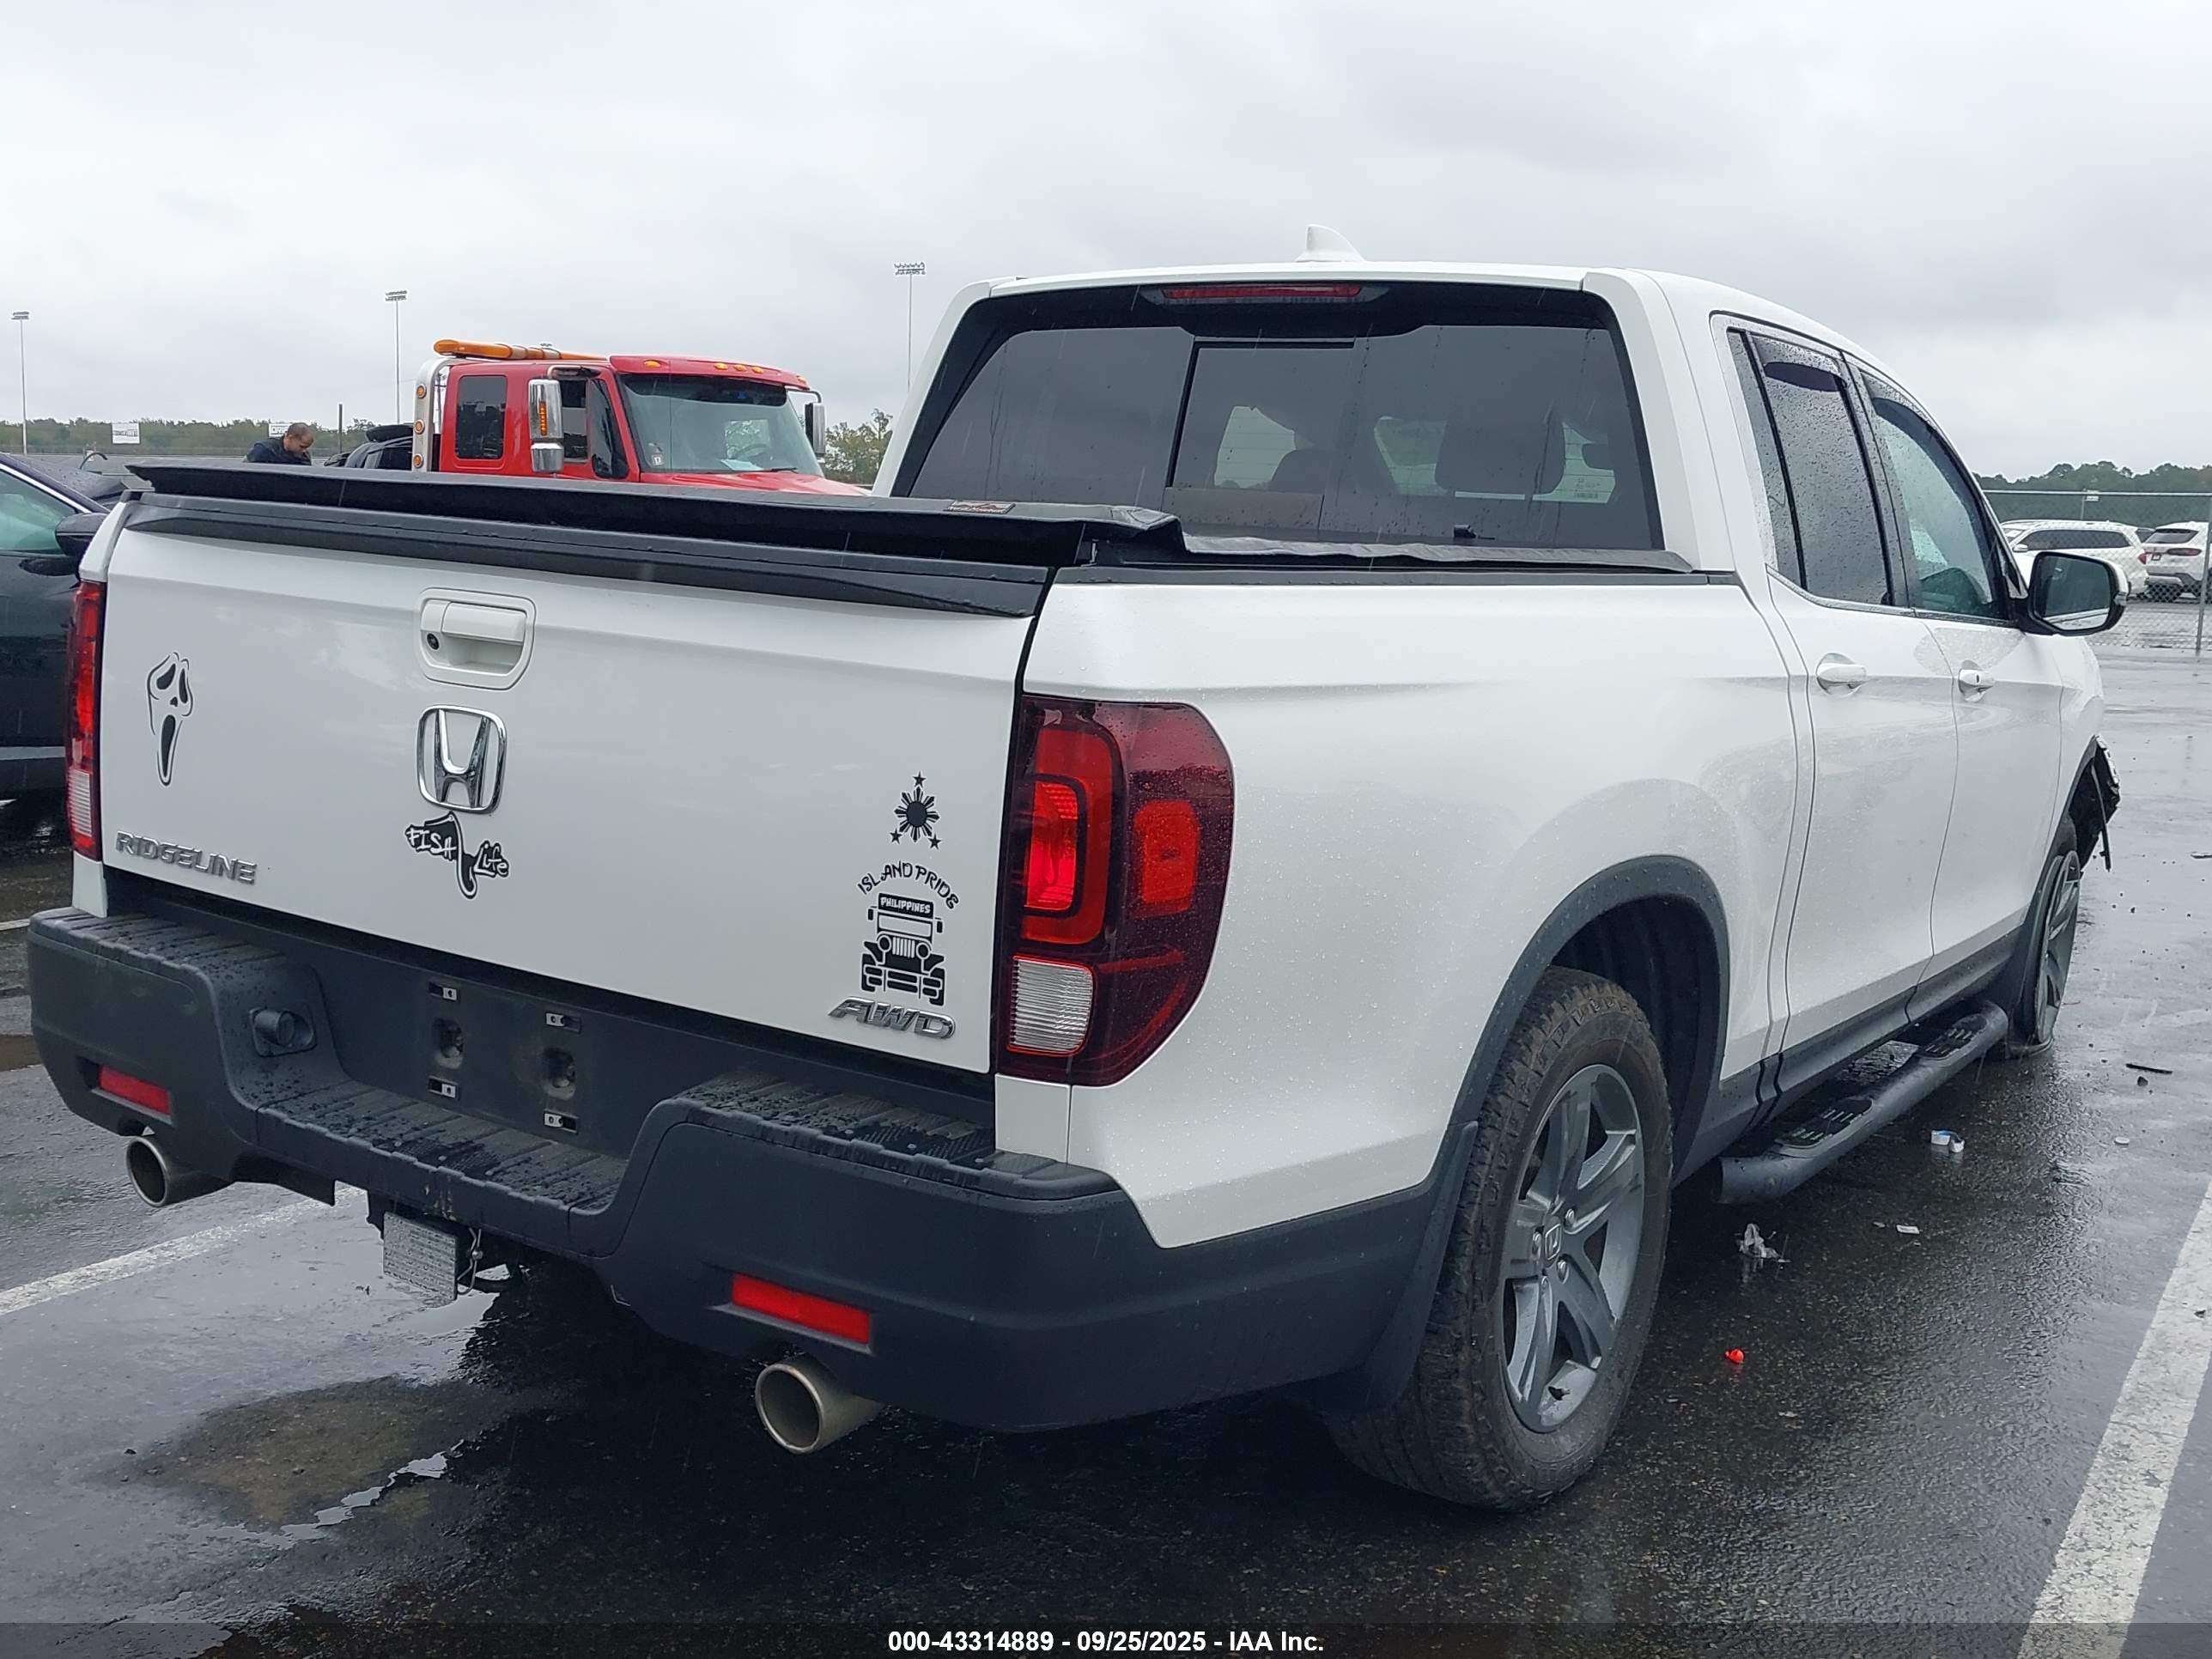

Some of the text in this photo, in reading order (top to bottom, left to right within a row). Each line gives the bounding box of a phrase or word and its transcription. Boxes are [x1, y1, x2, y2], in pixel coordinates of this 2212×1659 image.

[116, 830, 257, 885] RIDGELINE
[405, 827, 508, 876] FISH Life
[858, 860, 959, 909] ISLAND PRIDE
[879, 896, 931, 914] PHILIPPINES
[828, 996, 957, 1039] AWD
